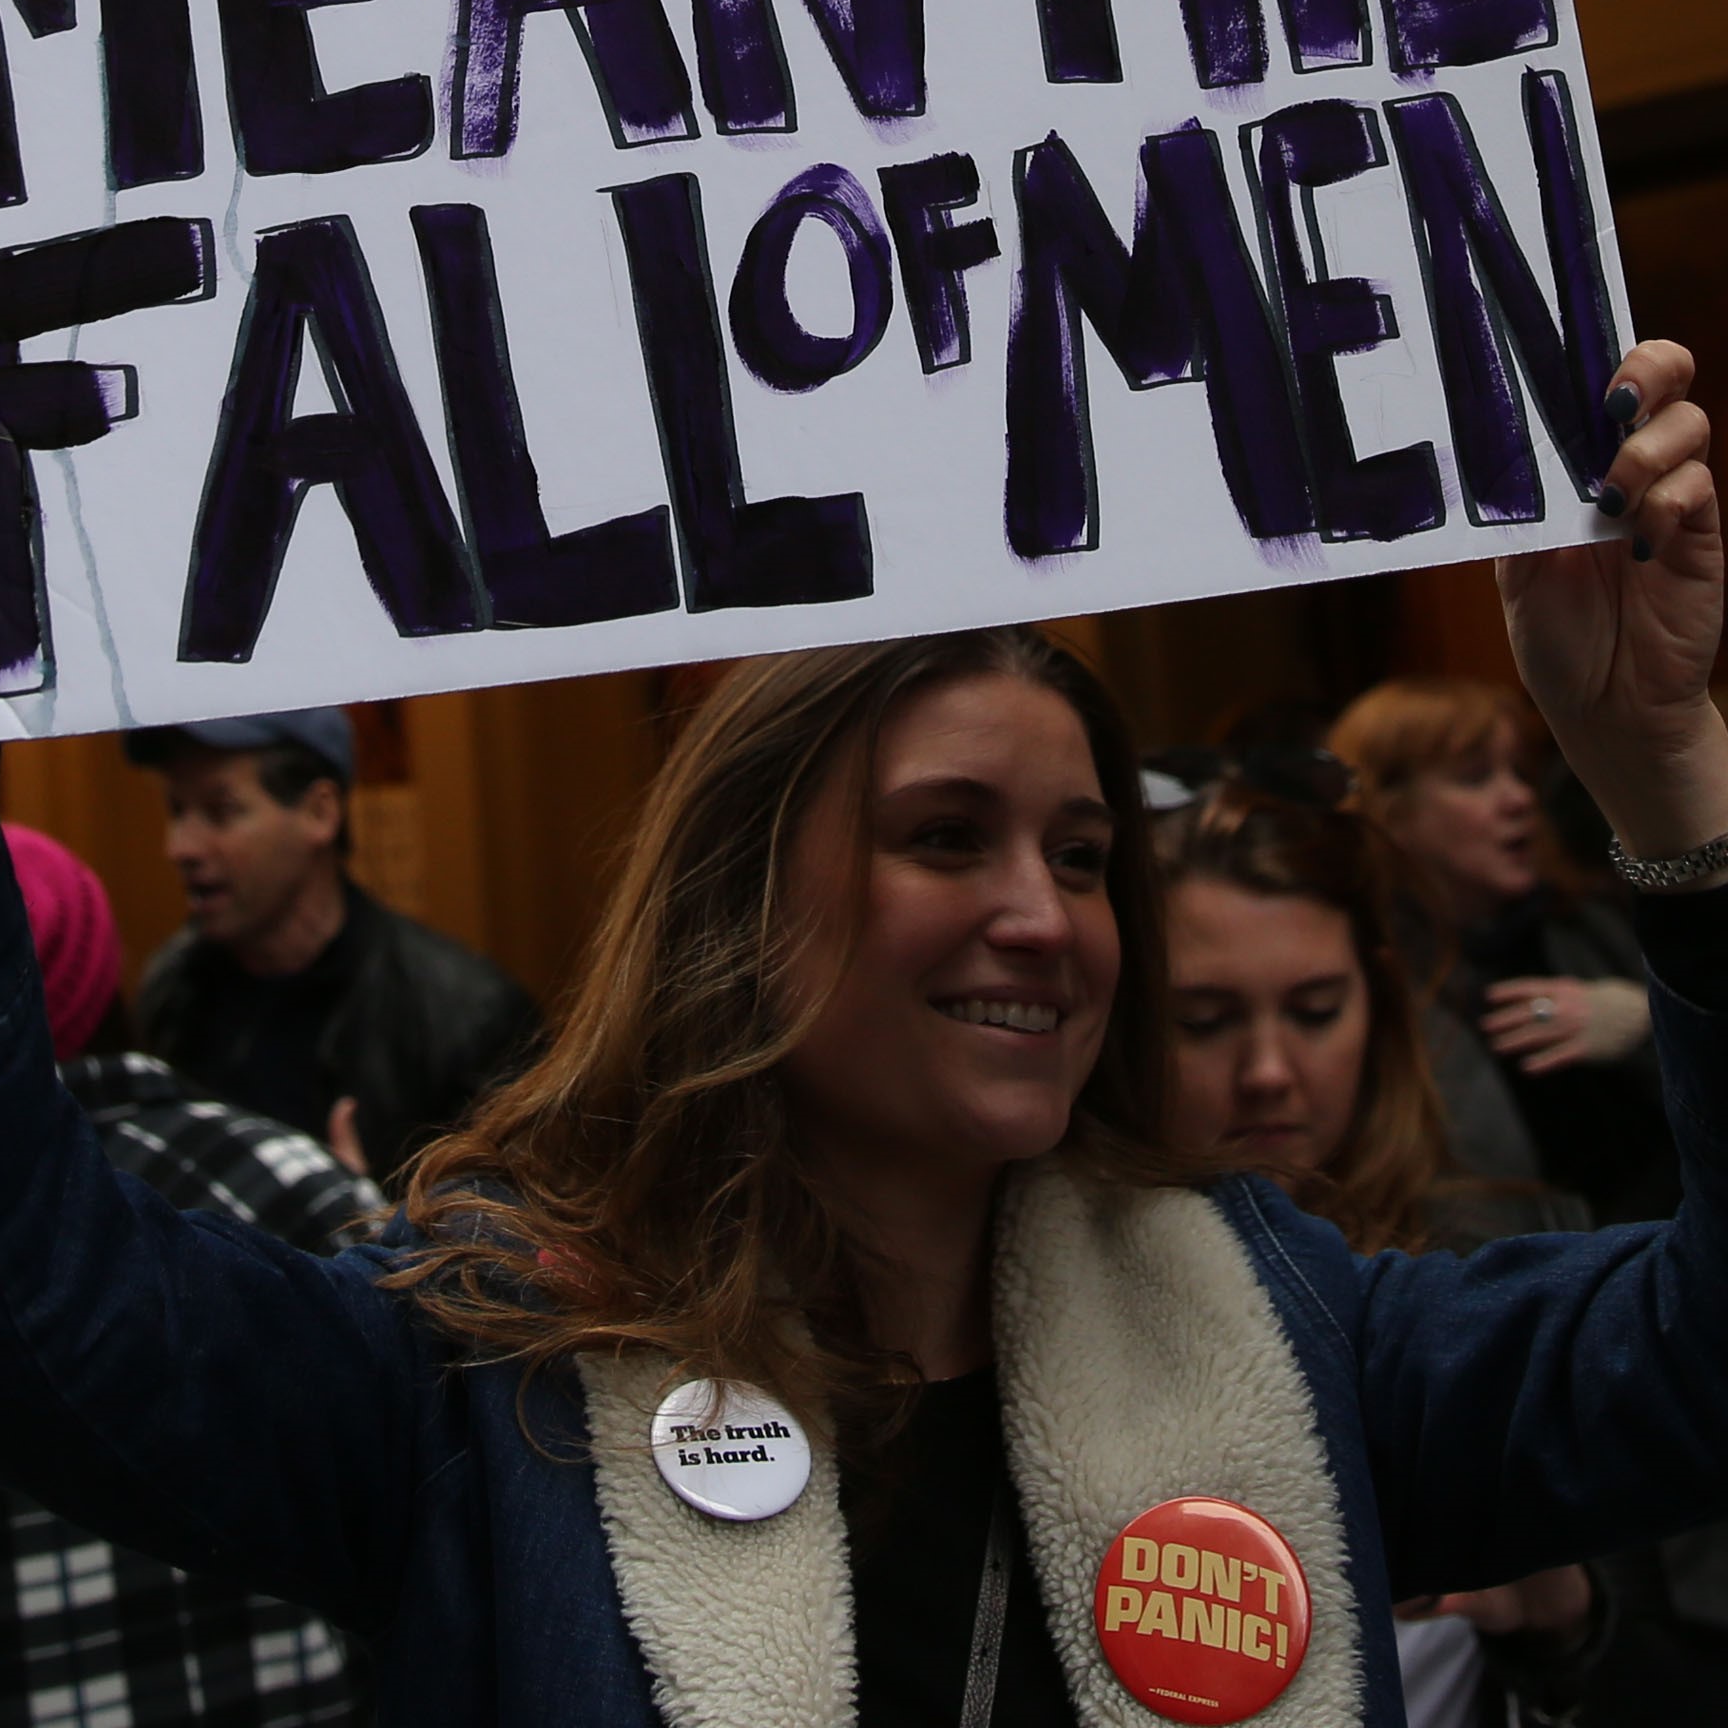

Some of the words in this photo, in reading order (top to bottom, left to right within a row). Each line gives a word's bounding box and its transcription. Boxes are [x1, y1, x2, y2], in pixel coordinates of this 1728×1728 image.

[728, 152, 1001, 394] OF
[1004, 65, 1626, 560] MEN
[671, 1424, 721, 1443] The
[724, 1421, 791, 1440] truth
[678, 1449, 701, 1466] is
[704, 1445, 775, 1464] hard.
[1122, 1536, 1286, 1615] DON'T
[1104, 1585, 1288, 1669] PANIC!
[1188, 1695, 1219, 1708] EXPRESS
